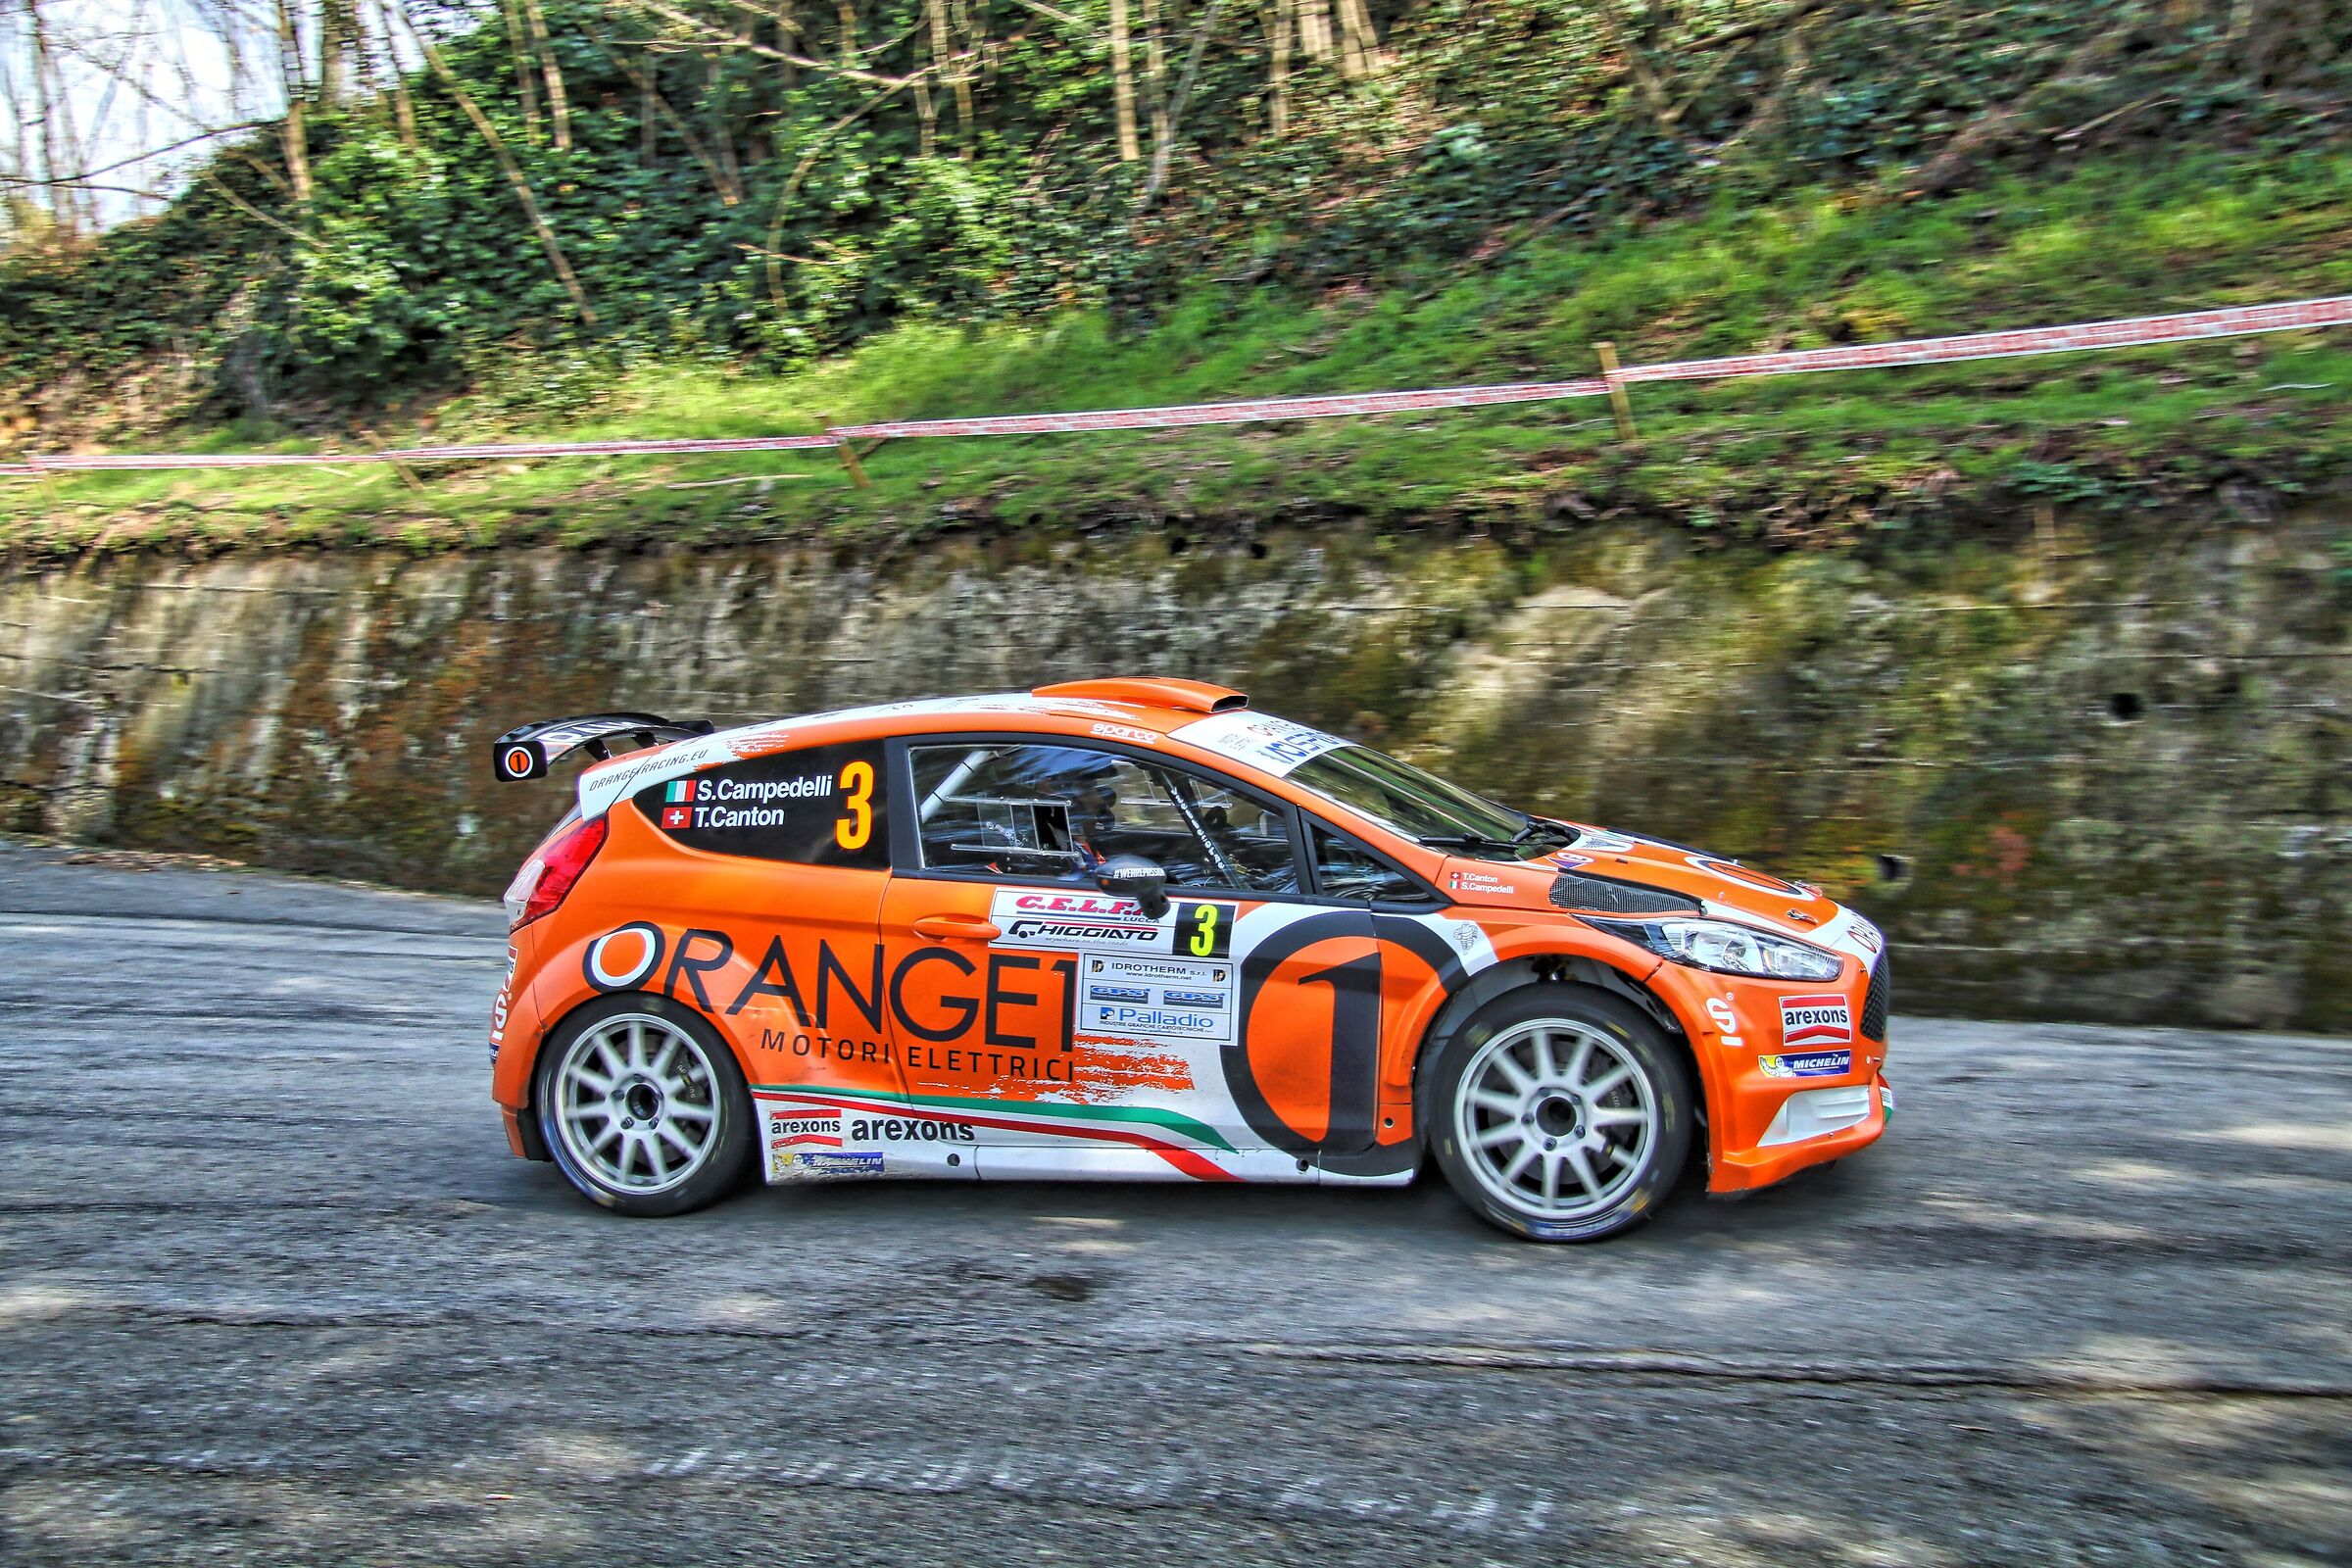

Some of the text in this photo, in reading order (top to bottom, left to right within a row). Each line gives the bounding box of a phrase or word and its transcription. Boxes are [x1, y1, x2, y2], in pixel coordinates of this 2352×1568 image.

[1091, 723, 1157, 744] sparco
[697, 775, 833, 804] S.Campedelli
[835, 760, 875, 851] 3
[695, 807, 785, 829] T.Canton
[1461, 882, 1514, 894] S.Campedelli
[1462, 872, 1498, 883] T.Canton
[1015, 896, 1145, 916] C.E.L.F.
[1008, 920, 1158, 941] CHIGGIATO
[1188, 904, 1218, 957] 3
[1111, 962, 1187, 976] IDROTHERM
[582, 920, 1076, 1054] ORANGE1
[1119, 1008, 1213, 1028] Palladio
[1785, 1009, 1848, 1025] arexons
[760, 1028, 1075, 1083] MOTORI ELETTRICI
[1793, 1056, 1850, 1070] MICHELIN
[771, 1119, 841, 1135] arexons
[852, 1118, 976, 1142] arexons
